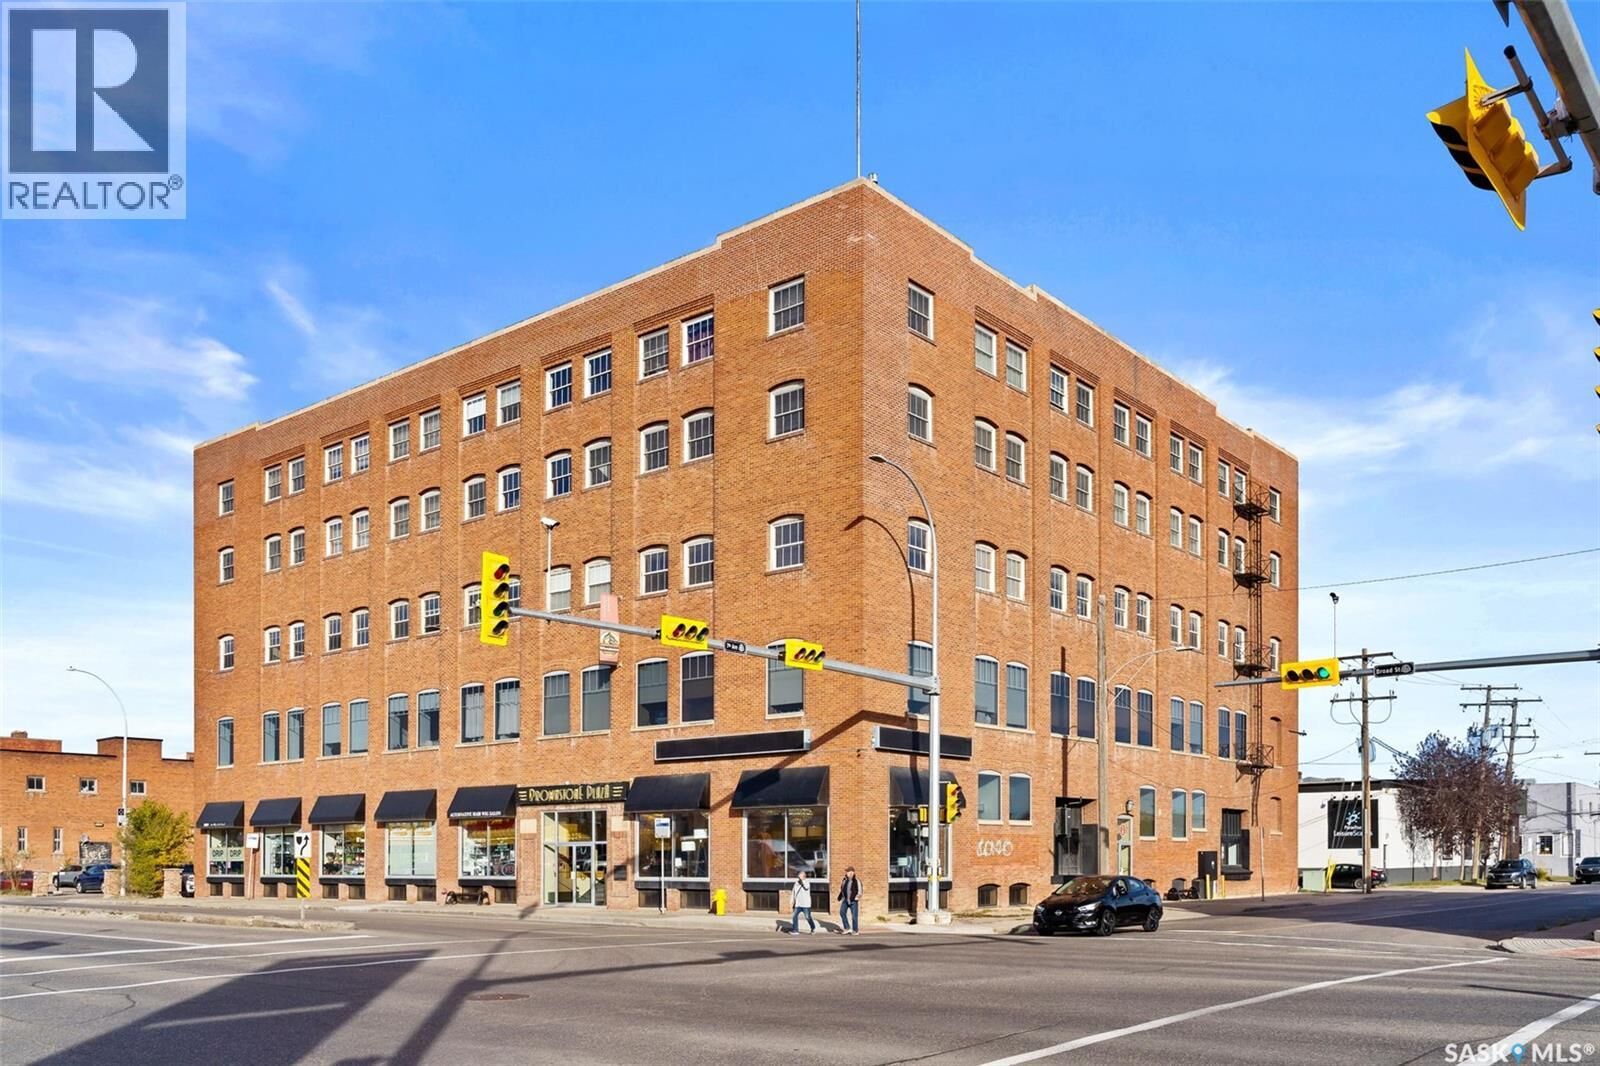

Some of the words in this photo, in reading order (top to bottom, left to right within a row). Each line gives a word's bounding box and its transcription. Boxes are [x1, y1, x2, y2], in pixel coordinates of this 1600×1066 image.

[1376, 667, 1393, 675] Broad
[212, 849, 223, 857] DRIP
[230, 849, 241, 857] DRIP
